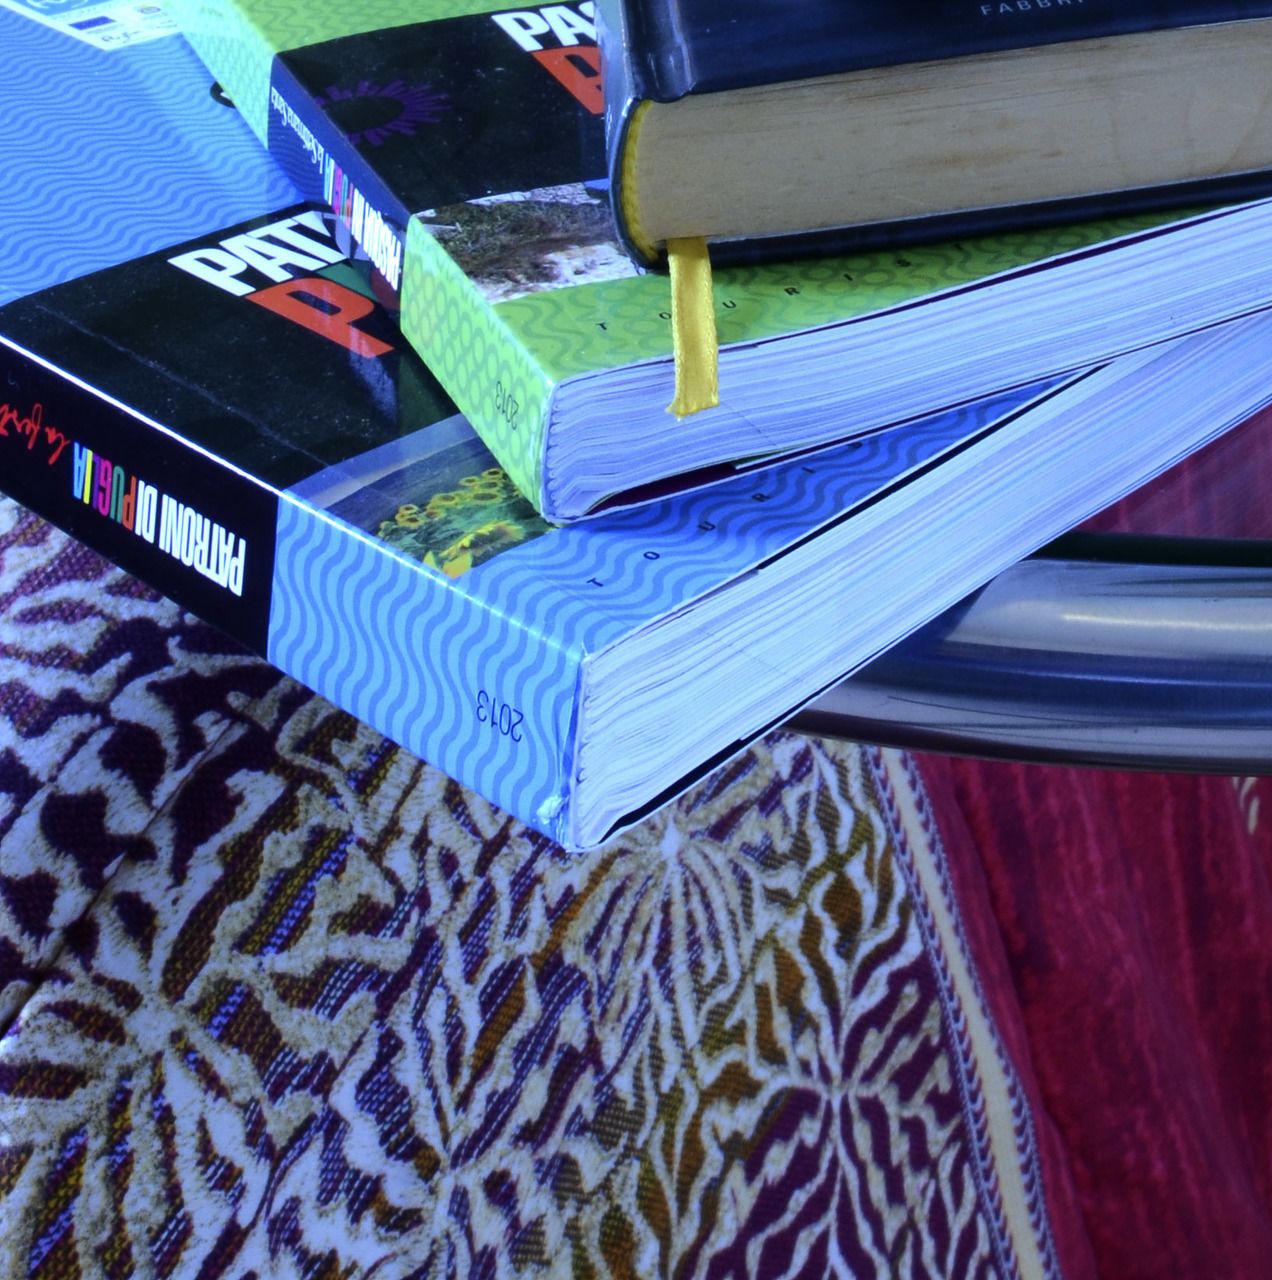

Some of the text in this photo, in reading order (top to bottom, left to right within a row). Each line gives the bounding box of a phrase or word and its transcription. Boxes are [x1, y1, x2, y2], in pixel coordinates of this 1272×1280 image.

[0, 402, 43, 451] fest
[495, 380, 520, 431] 2013
[72, 440, 137, 532] PUGLIA
[134, 479, 158, 544] DI
[158, 493, 247, 597] PATRONI
[476, 689, 524, 743] 2013
